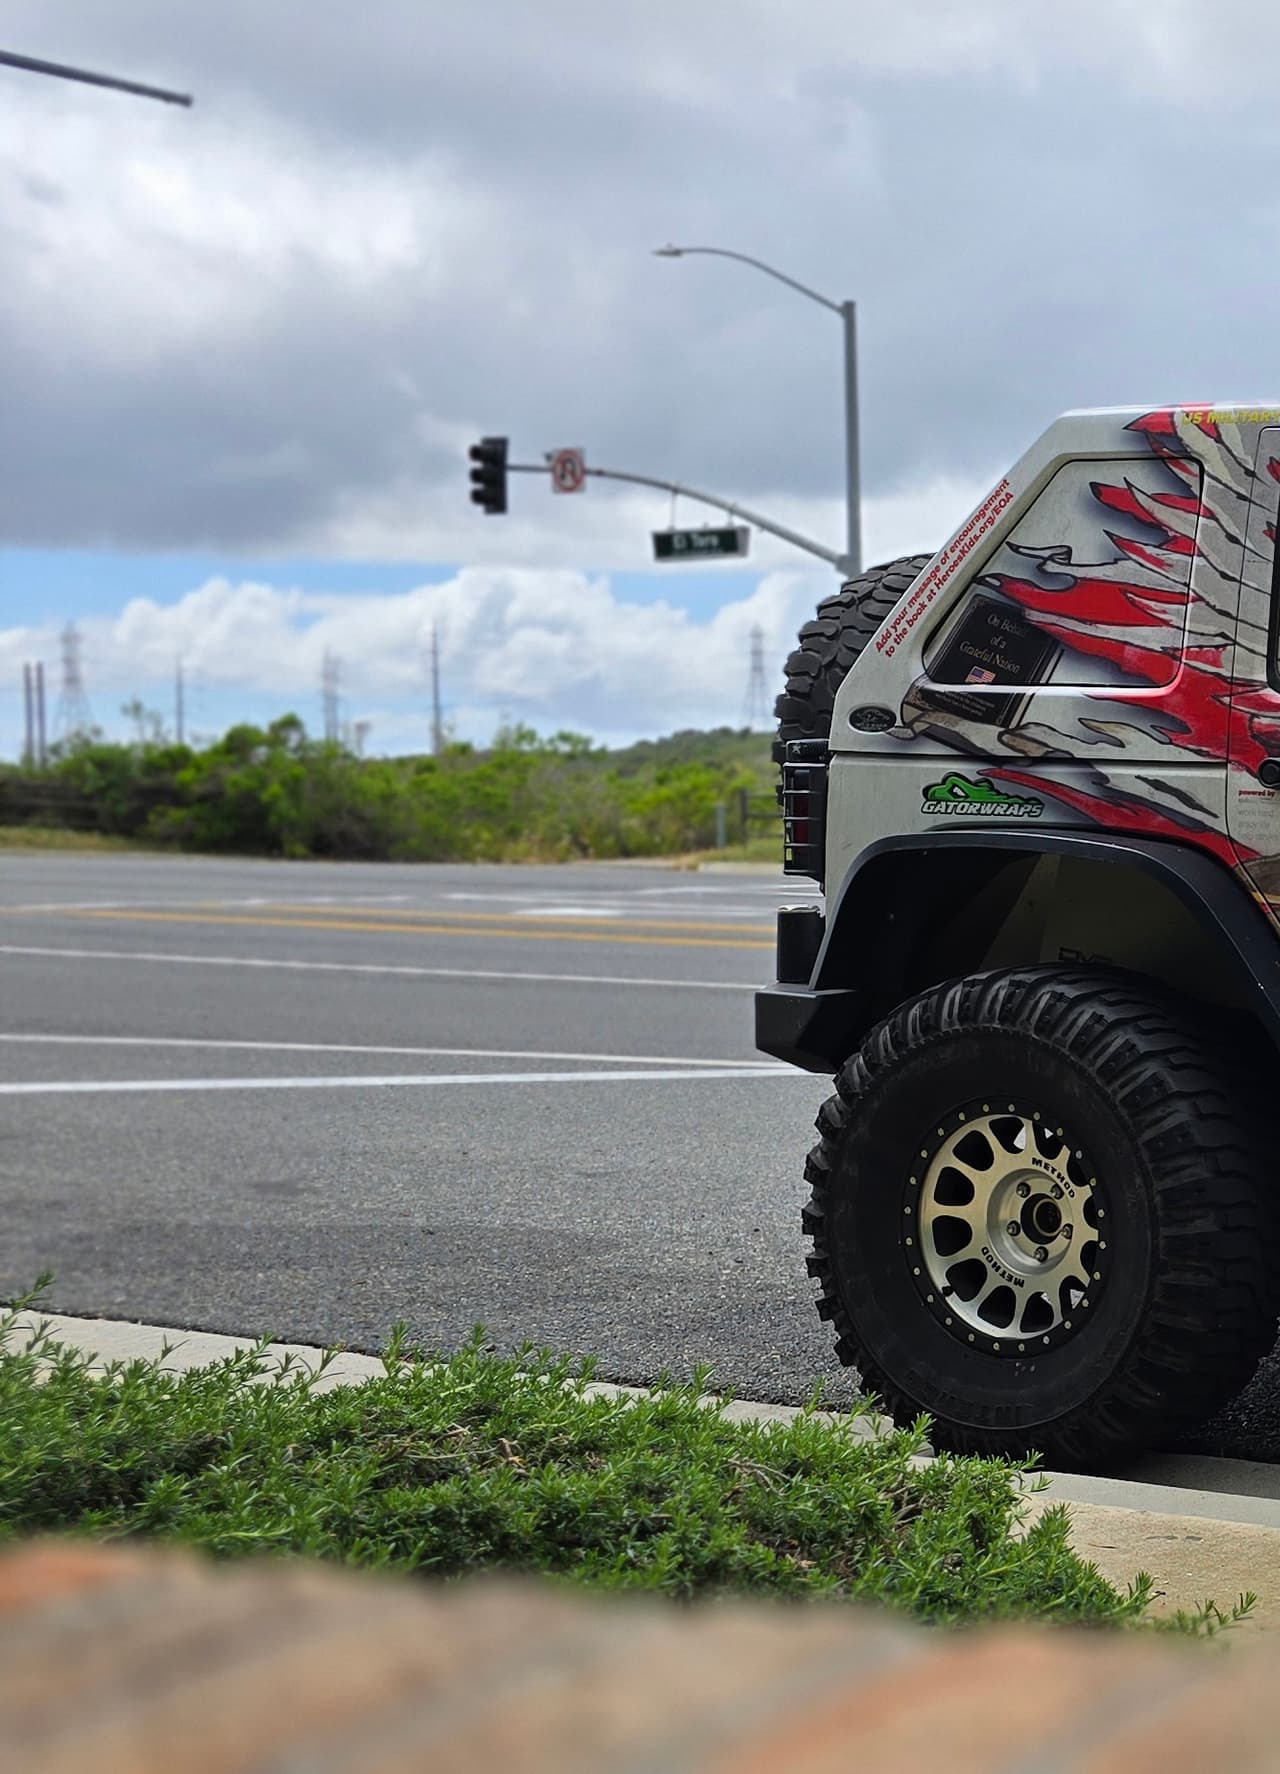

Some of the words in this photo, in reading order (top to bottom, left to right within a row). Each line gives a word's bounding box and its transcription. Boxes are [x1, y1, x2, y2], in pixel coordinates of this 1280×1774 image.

[1182, 412, 1201, 425] US
[875, 629, 893, 653] Add
[891, 609, 908, 634] your
[908, 565, 941, 609] message
[940, 550, 951, 567] of
[949, 479, 1010, 554] encouragement
[885, 645, 896, 658] to
[893, 627, 909, 646] the
[906, 602, 928, 630] book
[926, 588, 937, 603] at
[935, 492, 1014, 591] HeroesKids.org/EOA
[921, 800, 1045, 818] GATORWRAPS
[1030, 1157, 1076, 1199] METHOD
[980, 1245, 1026, 1289] METHOD
